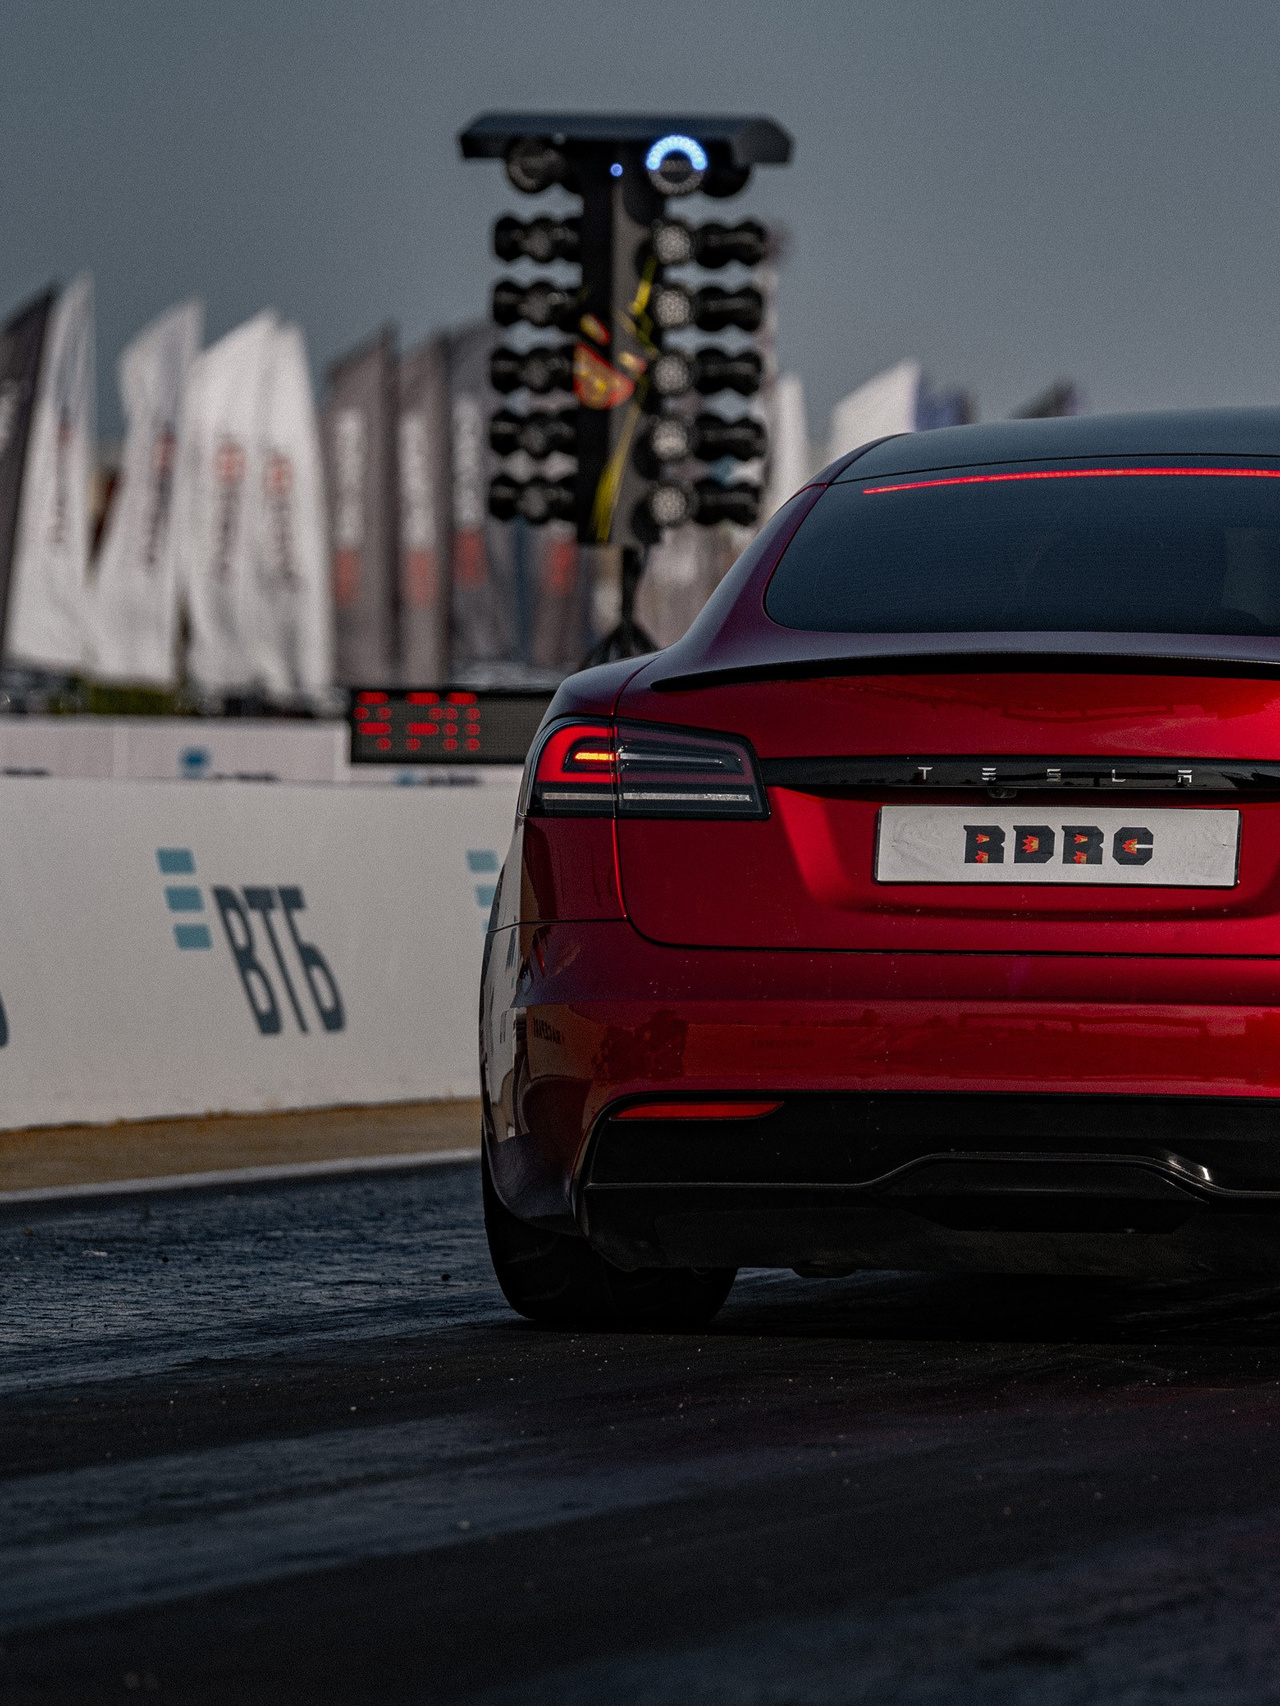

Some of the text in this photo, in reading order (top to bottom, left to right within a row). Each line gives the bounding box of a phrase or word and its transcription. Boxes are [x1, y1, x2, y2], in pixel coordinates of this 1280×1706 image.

[917, 766, 1193, 783] TESLA
[963, 824, 1154, 866] RDRC
[212, 886, 346, 1034] ВТБ
